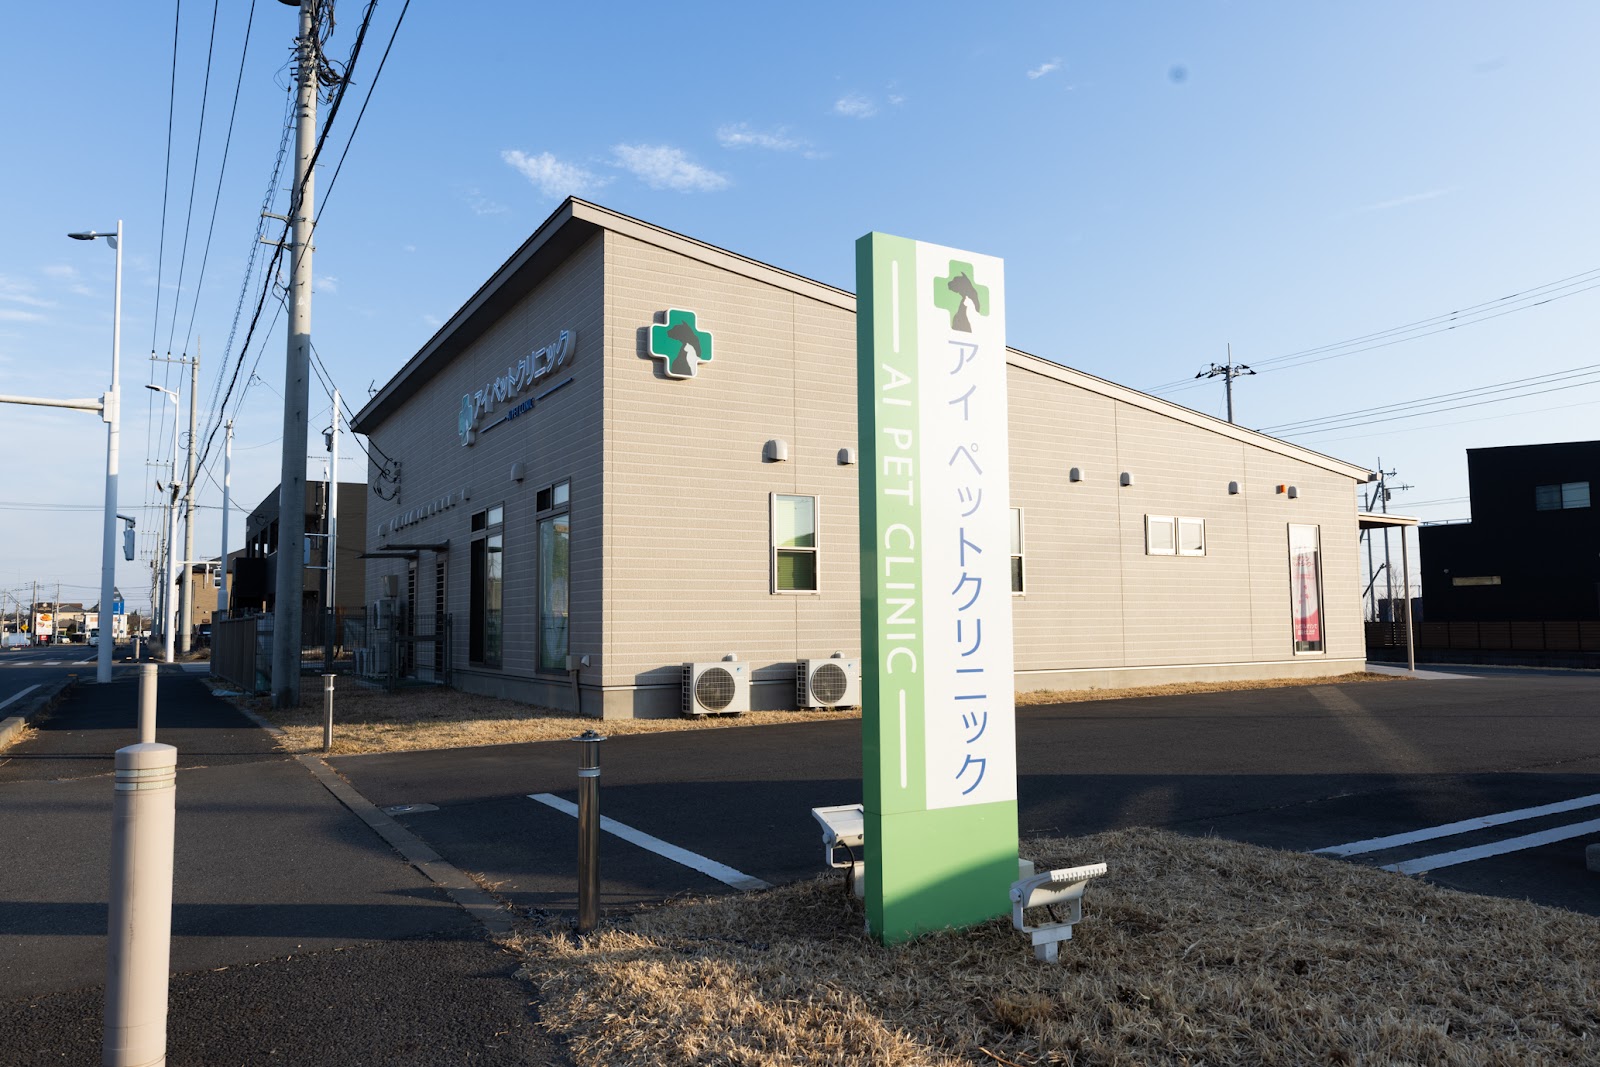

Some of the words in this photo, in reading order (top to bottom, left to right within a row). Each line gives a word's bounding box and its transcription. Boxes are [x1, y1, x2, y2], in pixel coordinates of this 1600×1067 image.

[474, 329, 571, 419] アイペットクリニック
[882, 363, 912, 407] AI
[883, 427, 914, 506] PET
[884, 523, 917, 674] CLINIC
[948, 339, 988, 796] アイペットクリニック
